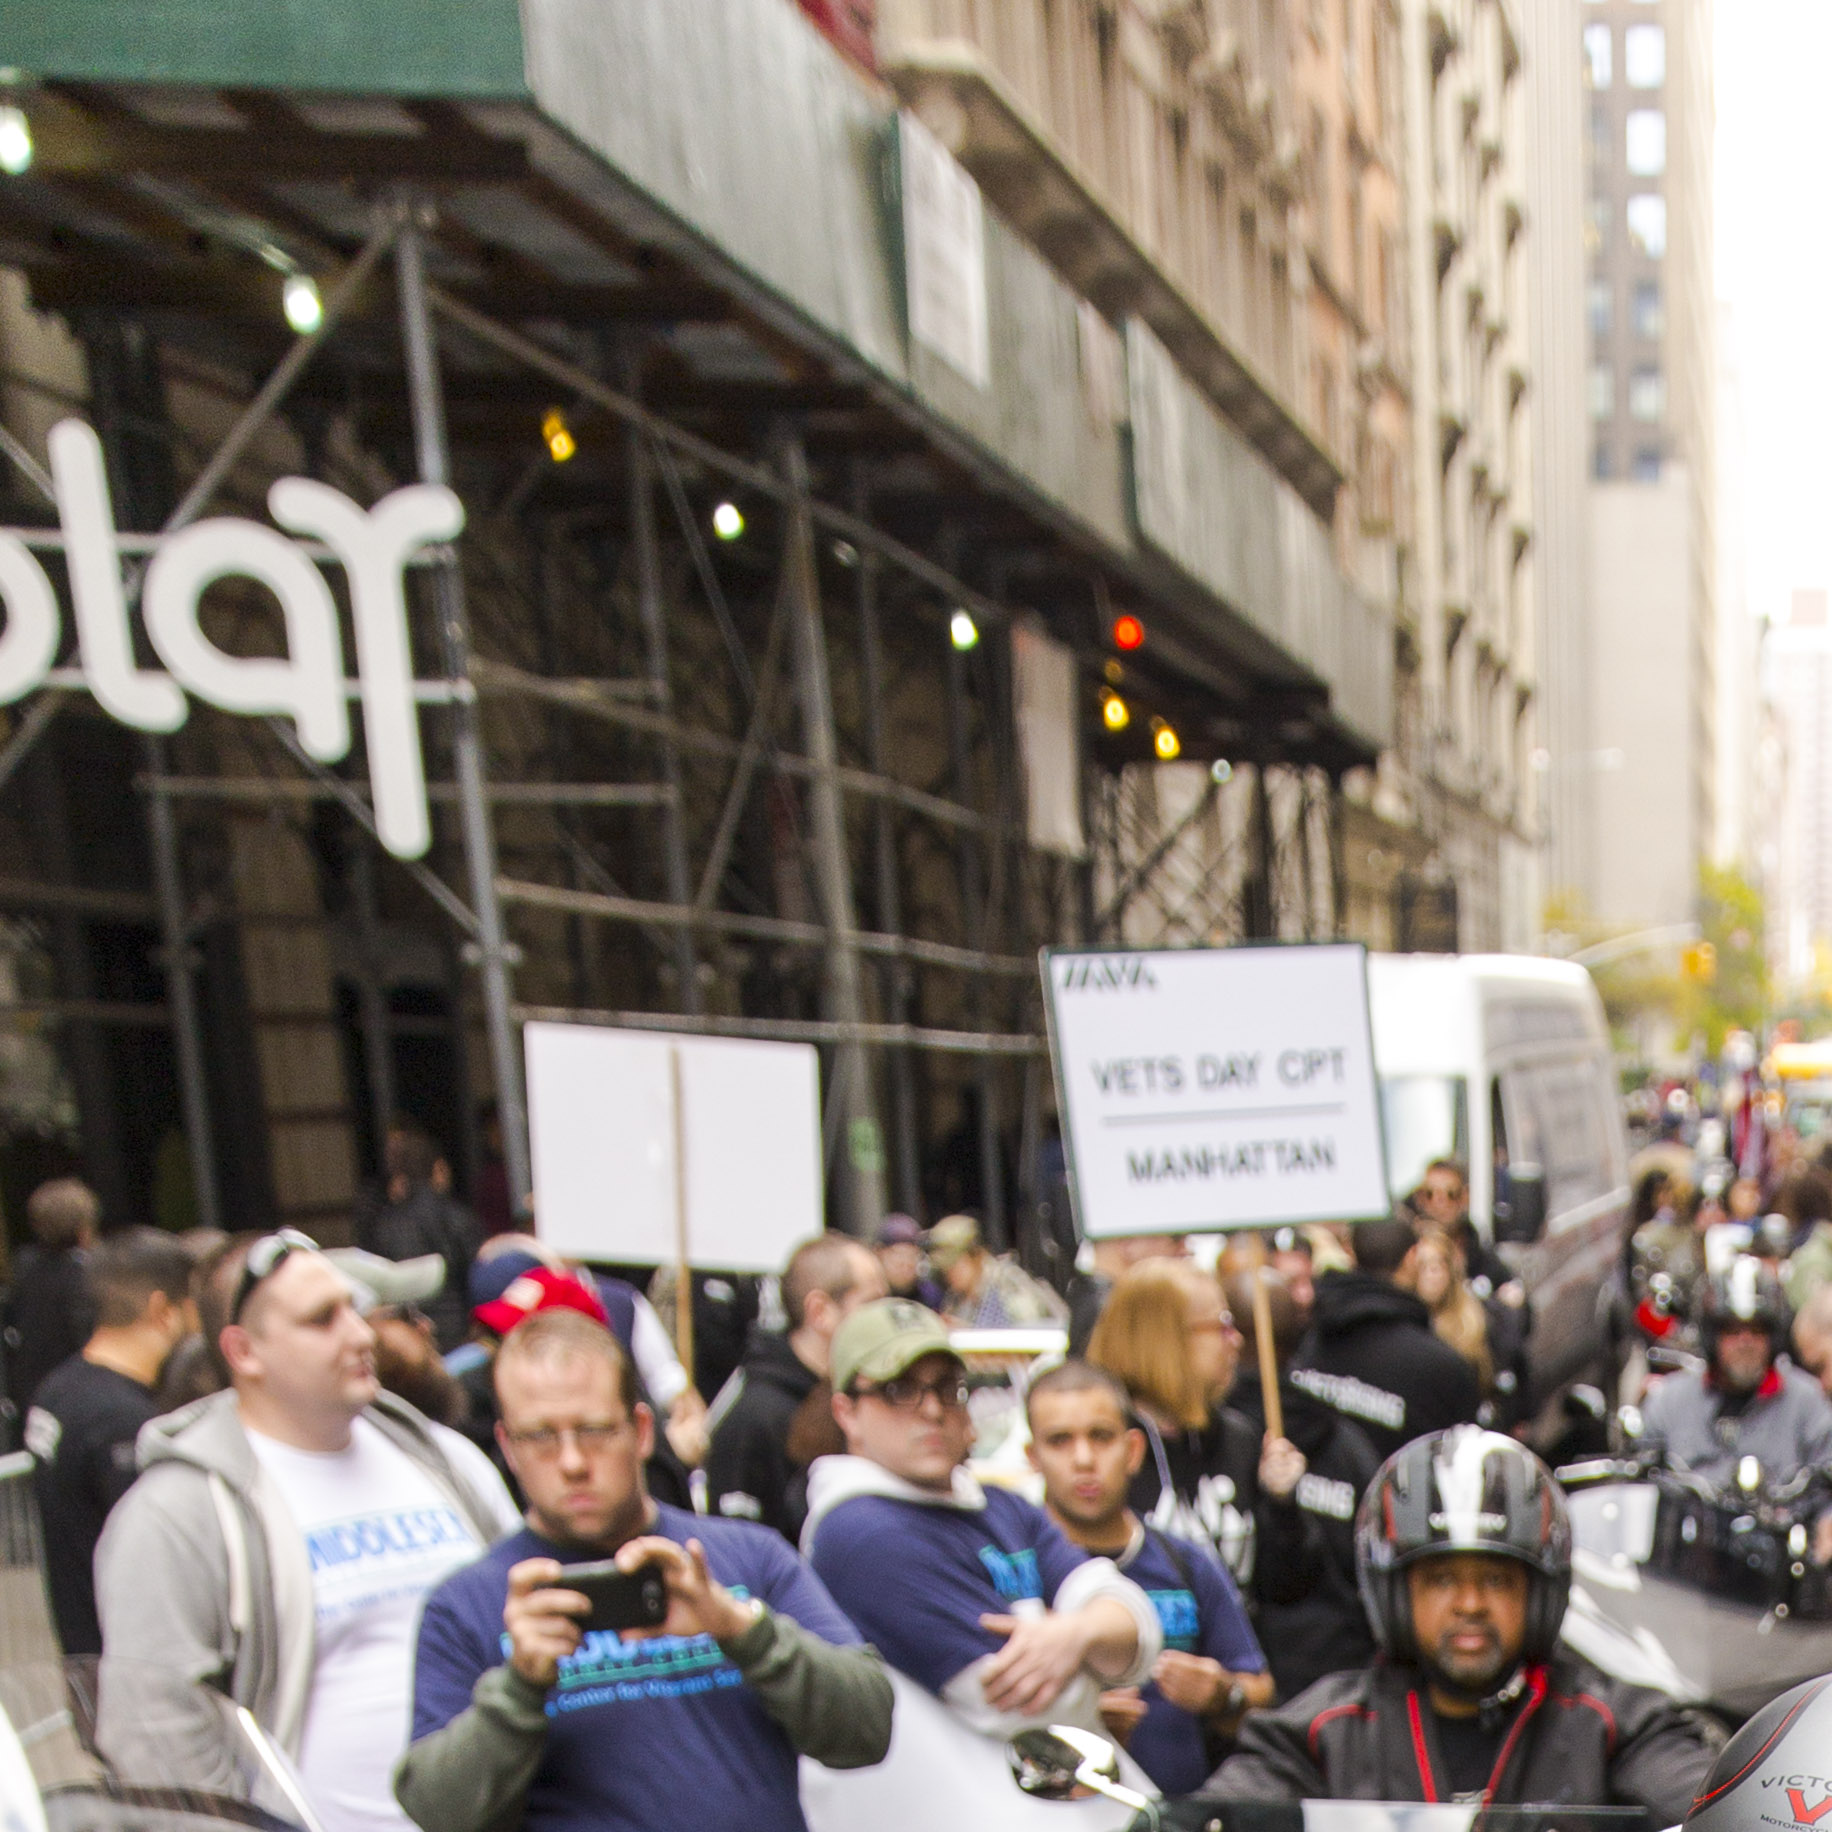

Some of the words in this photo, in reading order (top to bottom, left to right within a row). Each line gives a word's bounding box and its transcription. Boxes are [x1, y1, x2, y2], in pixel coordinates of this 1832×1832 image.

[1090, 1054, 1185, 1096] VETS
[1196, 1049, 1262, 1089] DAY
[1276, 1046, 1346, 1088] CPT
[1125, 1137, 1338, 1185] MANHATTAN
